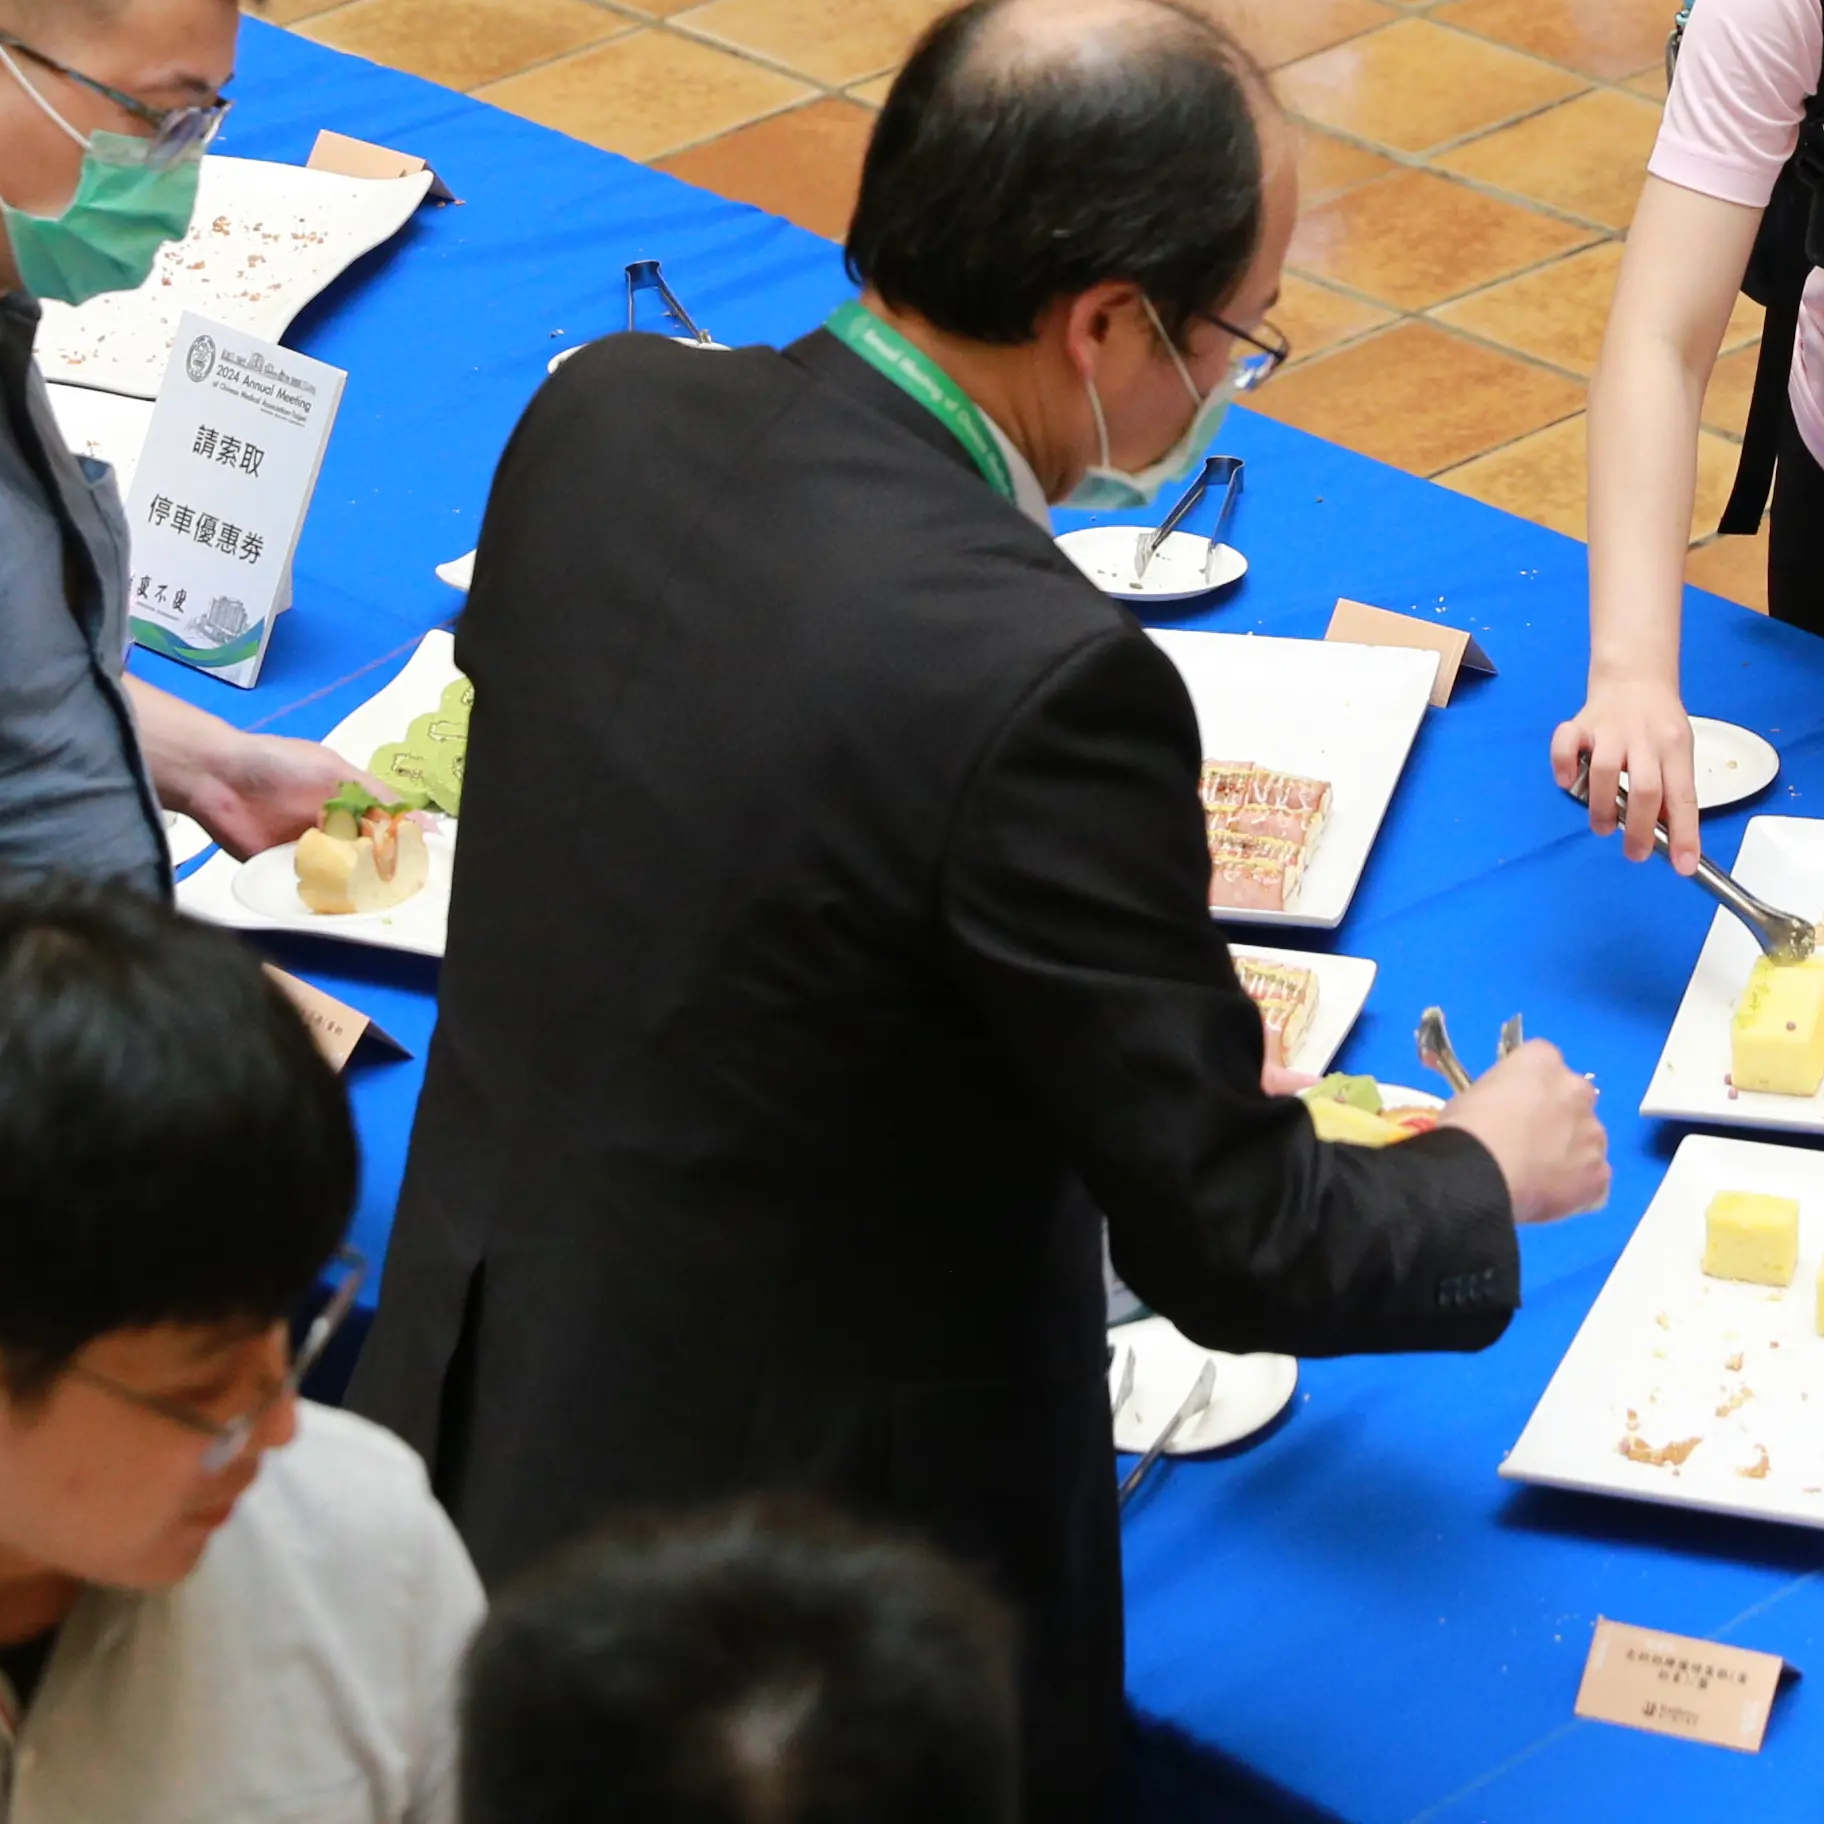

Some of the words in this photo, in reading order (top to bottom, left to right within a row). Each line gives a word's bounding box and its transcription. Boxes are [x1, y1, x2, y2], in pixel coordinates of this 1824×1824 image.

[215, 364, 241, 382] 2024
[242, 374, 275, 397] Annual
[276, 387, 312, 413] Meeting
[192, 424, 265, 478] 請索取
